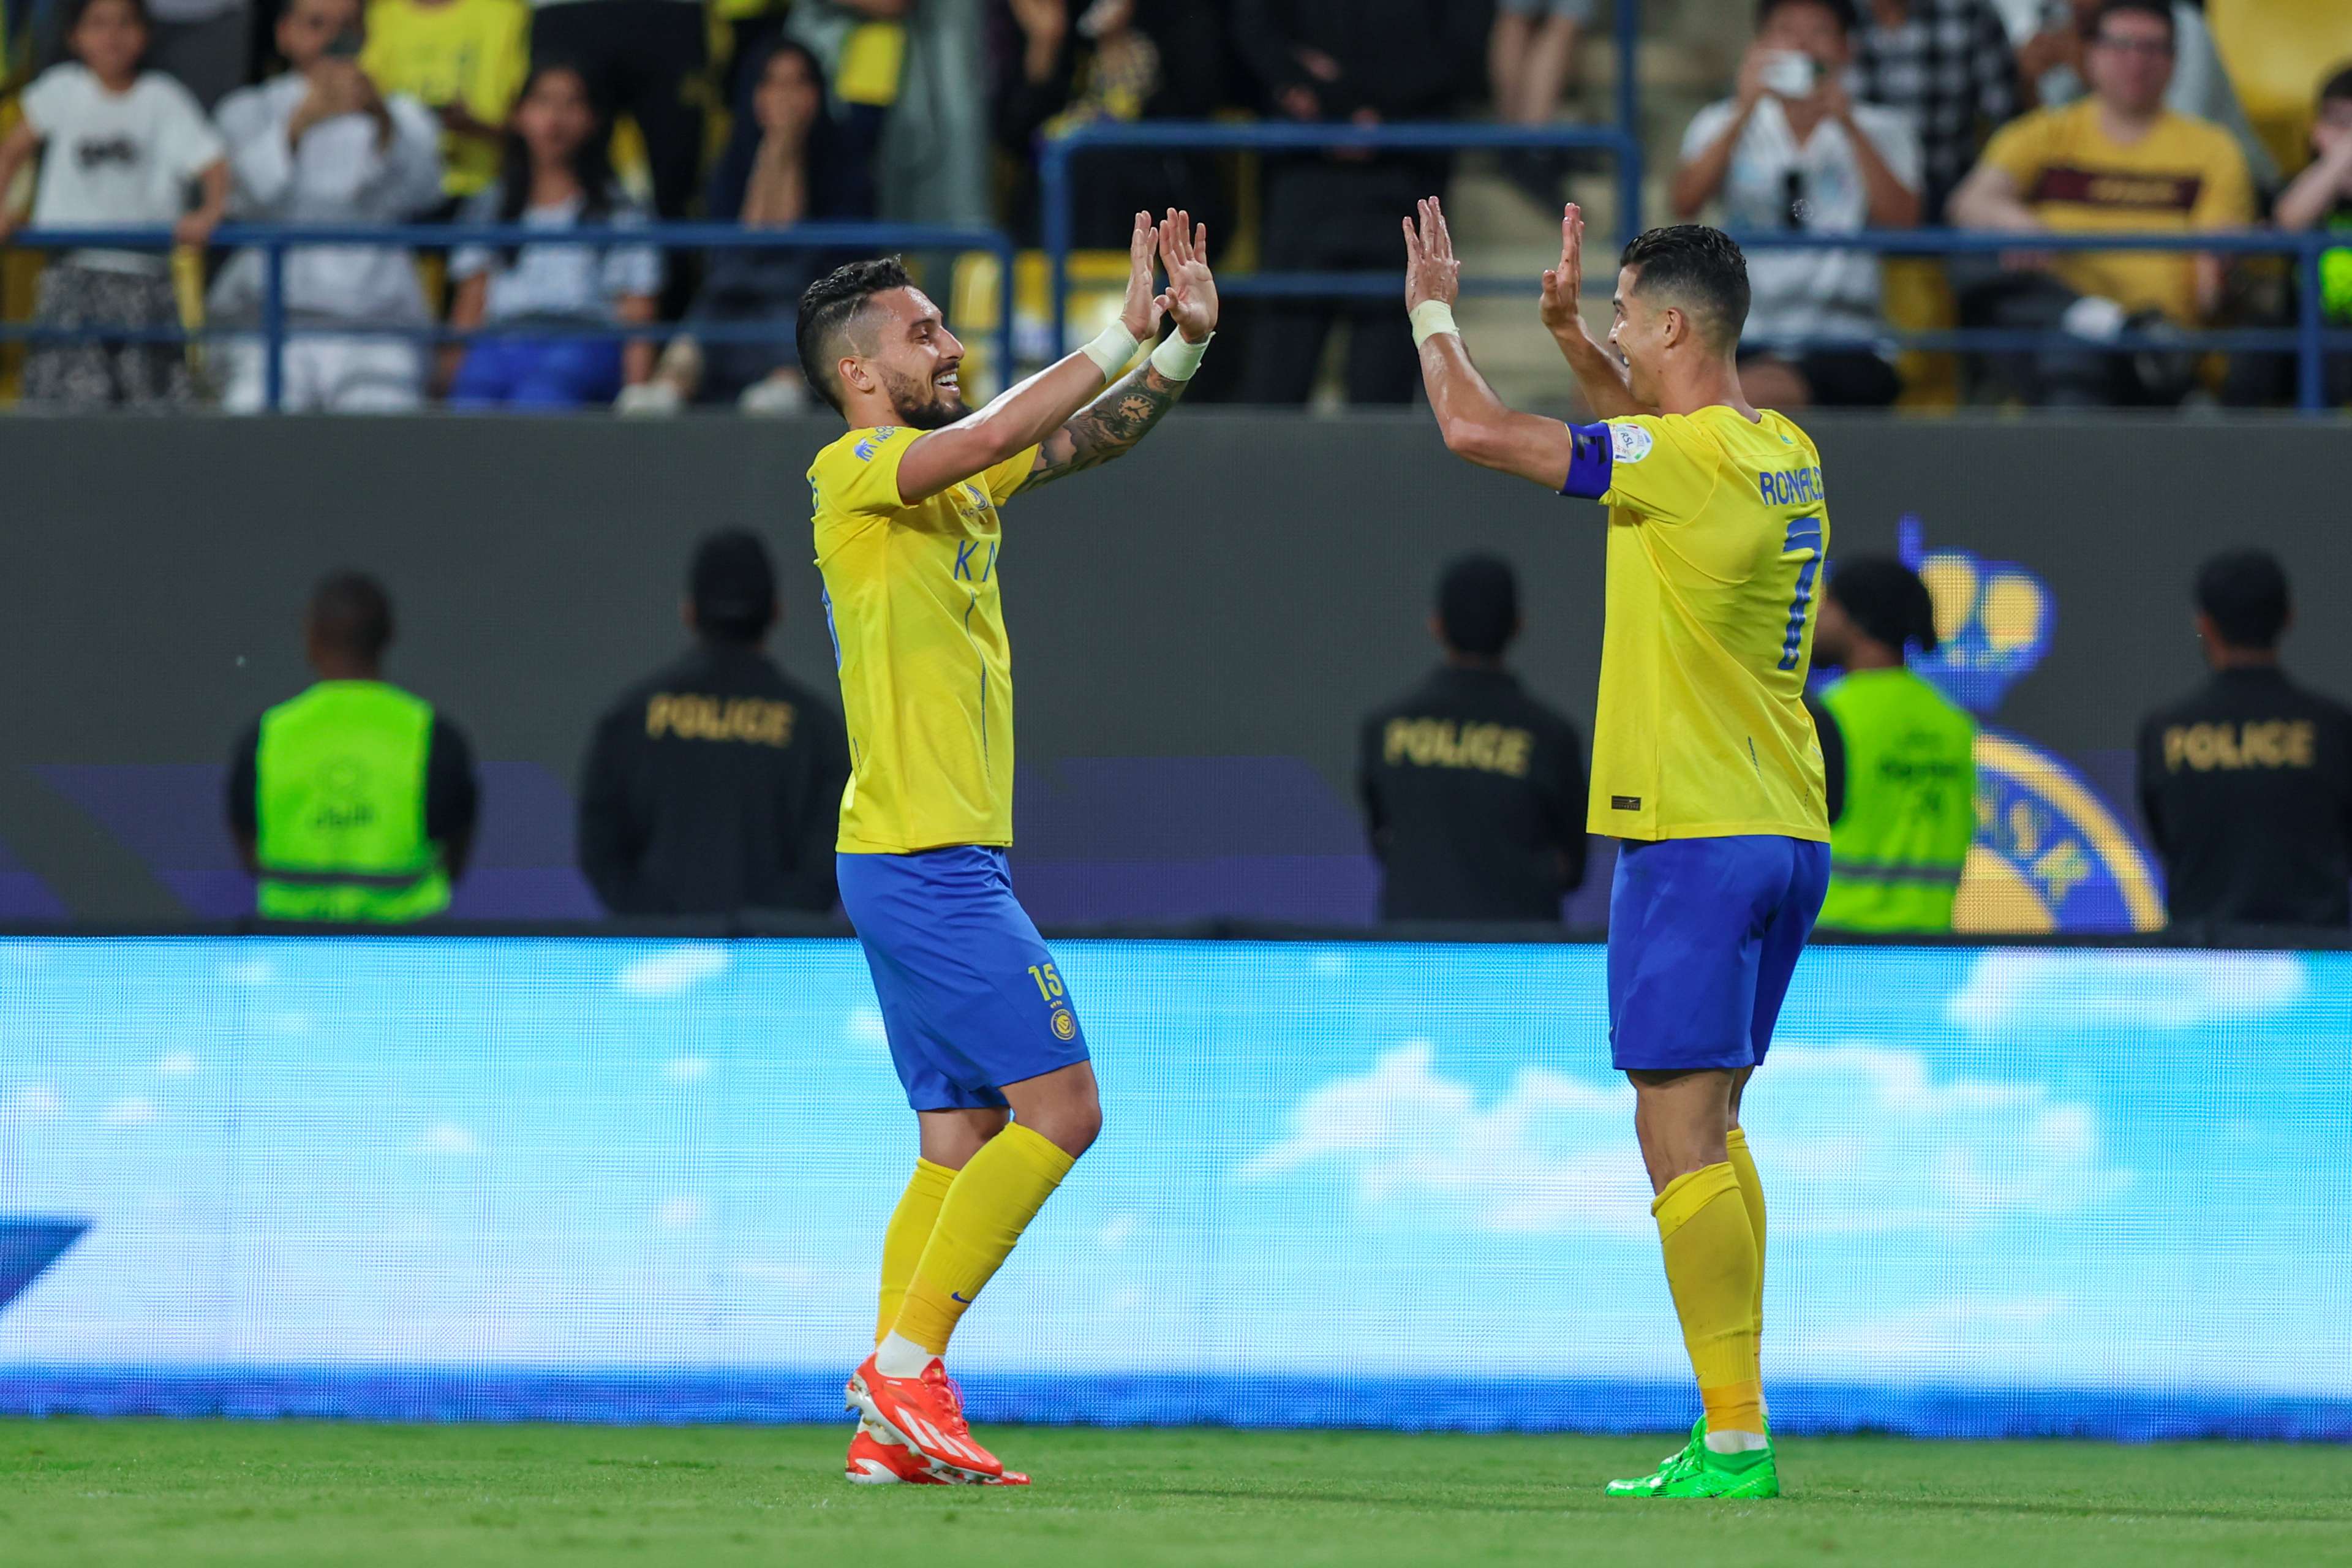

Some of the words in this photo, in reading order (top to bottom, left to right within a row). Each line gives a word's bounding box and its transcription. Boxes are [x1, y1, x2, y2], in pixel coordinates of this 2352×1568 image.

[1777, 517, 1823, 671] 7
[647, 695, 792, 746] POLICE
[2166, 720, 2314, 772] POLICE
[1385, 719, 1530, 777] POLICE
[1028, 963, 1063, 1001] 15
